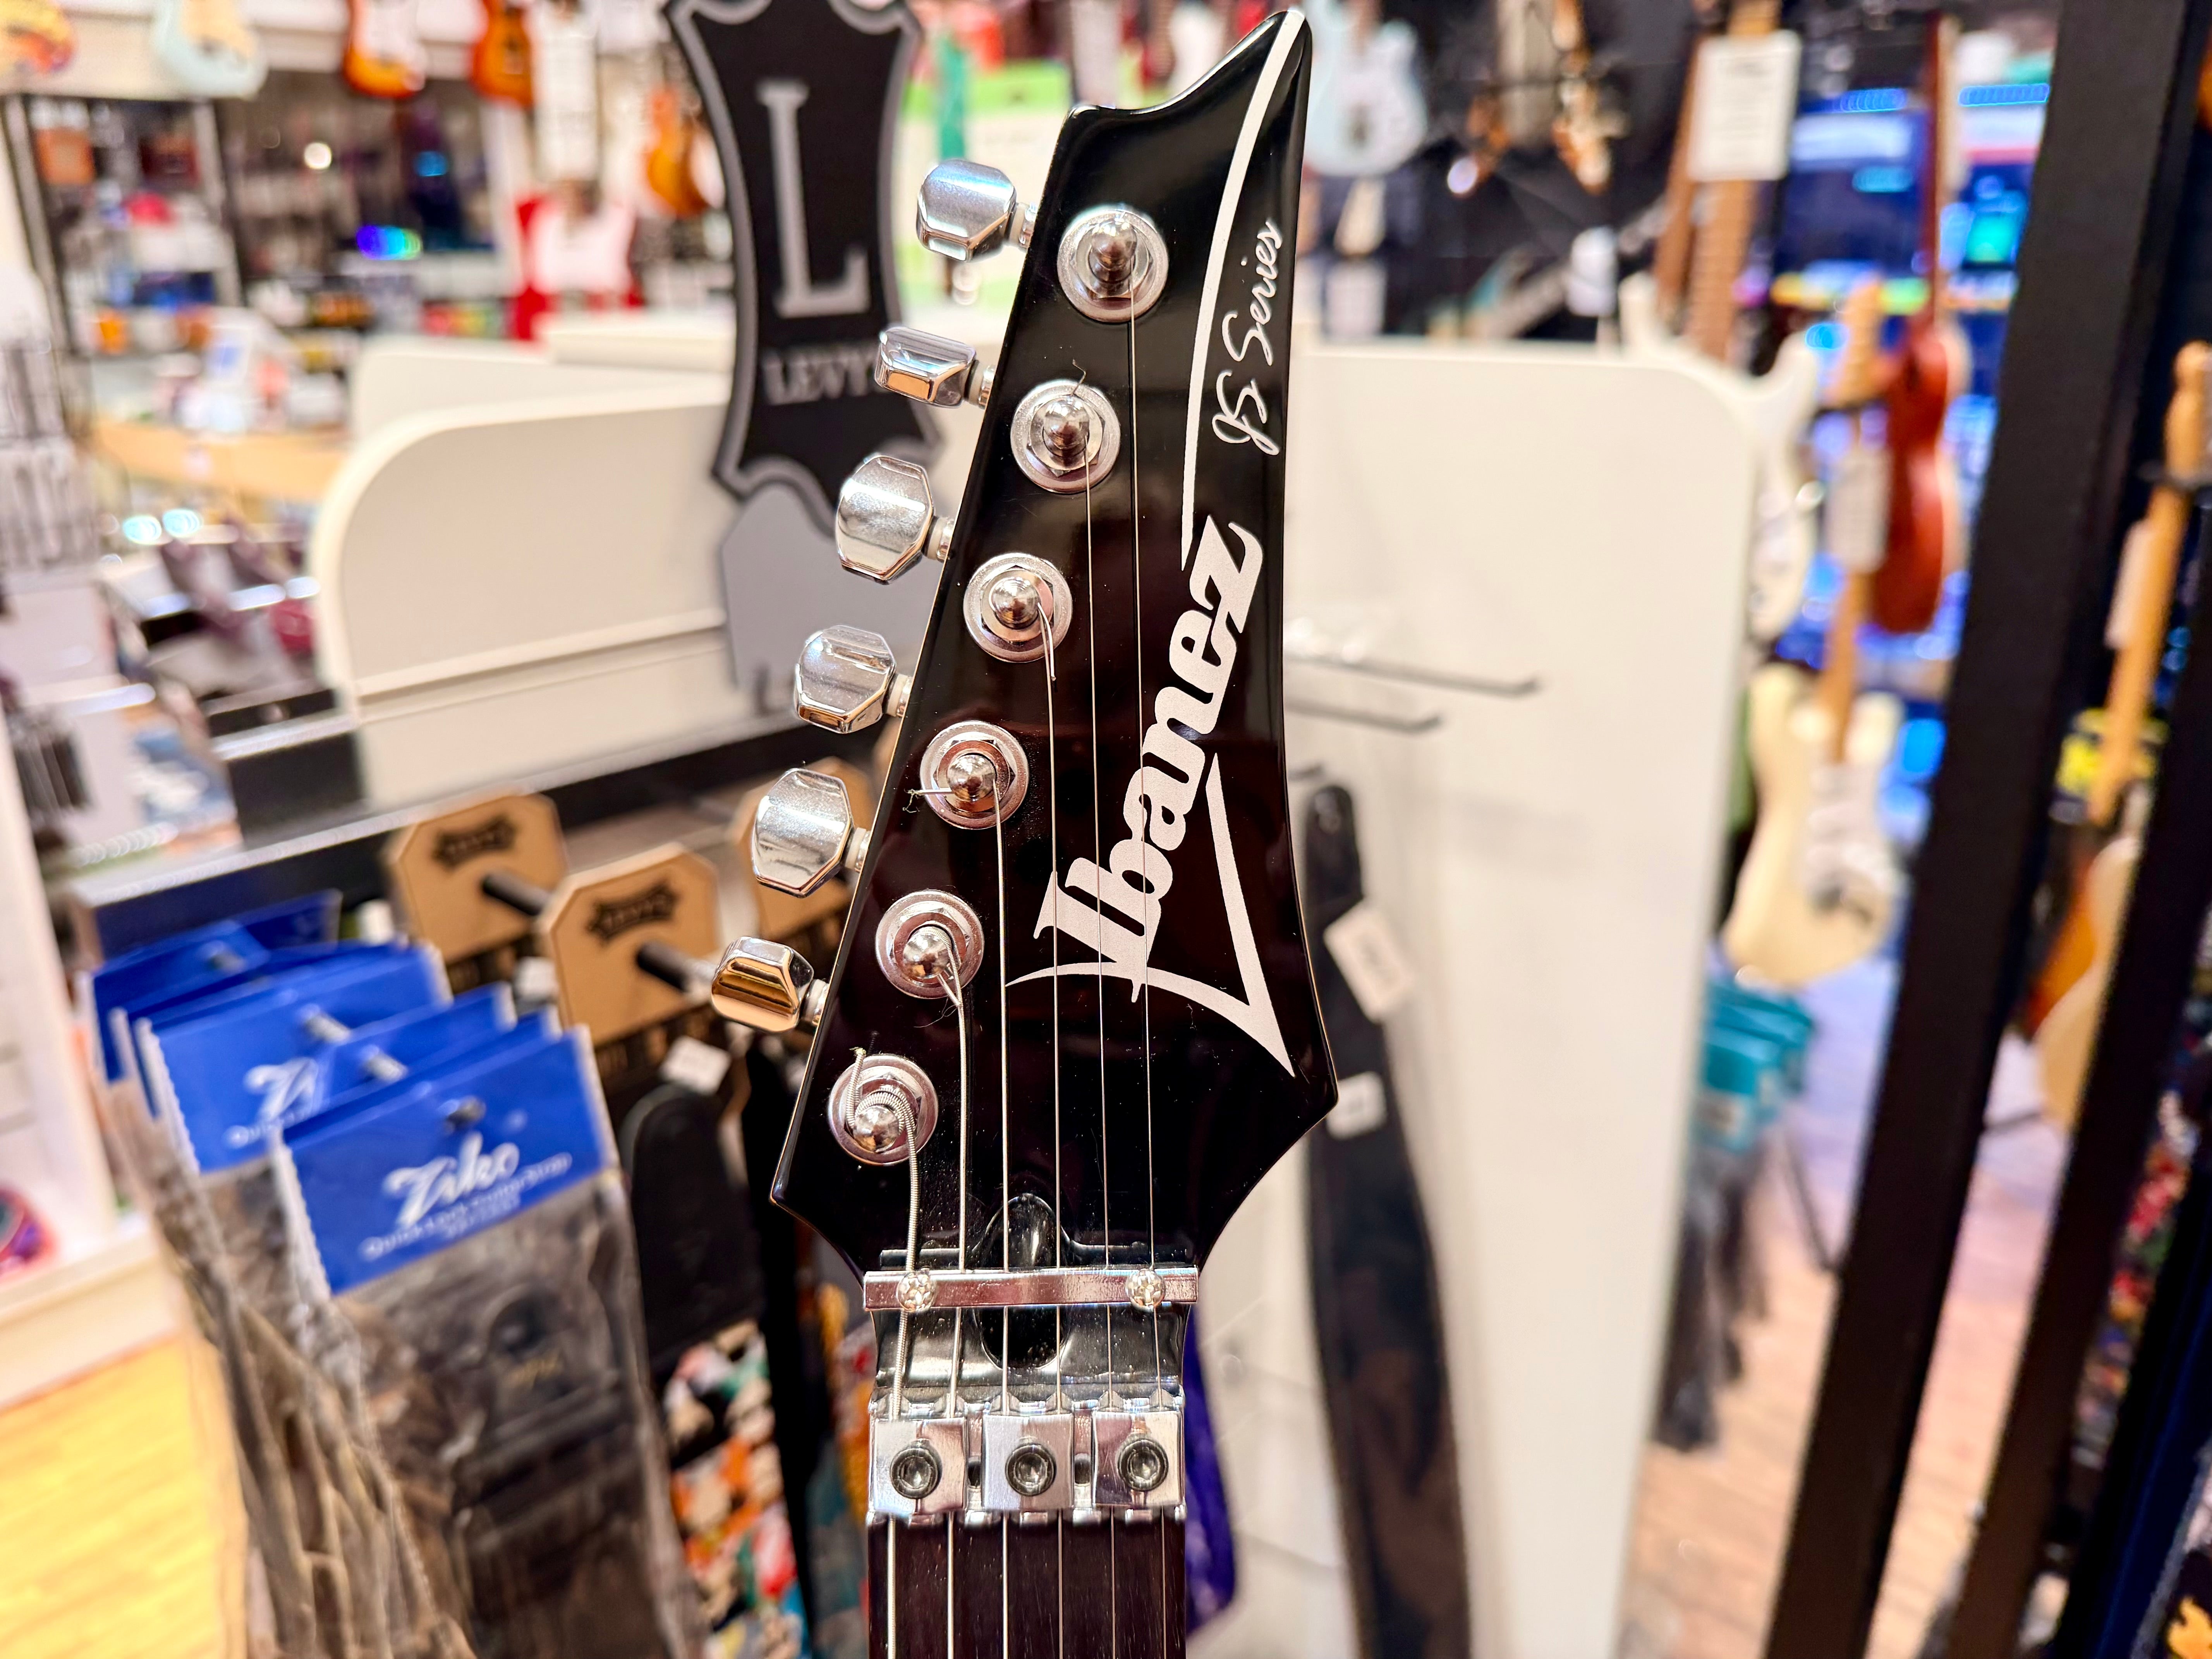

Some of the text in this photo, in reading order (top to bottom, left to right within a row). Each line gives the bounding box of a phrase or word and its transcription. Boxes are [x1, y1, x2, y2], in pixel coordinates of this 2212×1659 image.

[757, 79, 870, 318] L
[763, 347, 881, 405] LEVY
[1212, 218, 1283, 455] JS Series
[1032, 513, 1264, 1004] Ibanez
[383, 1131, 519, 1228] Ziko
